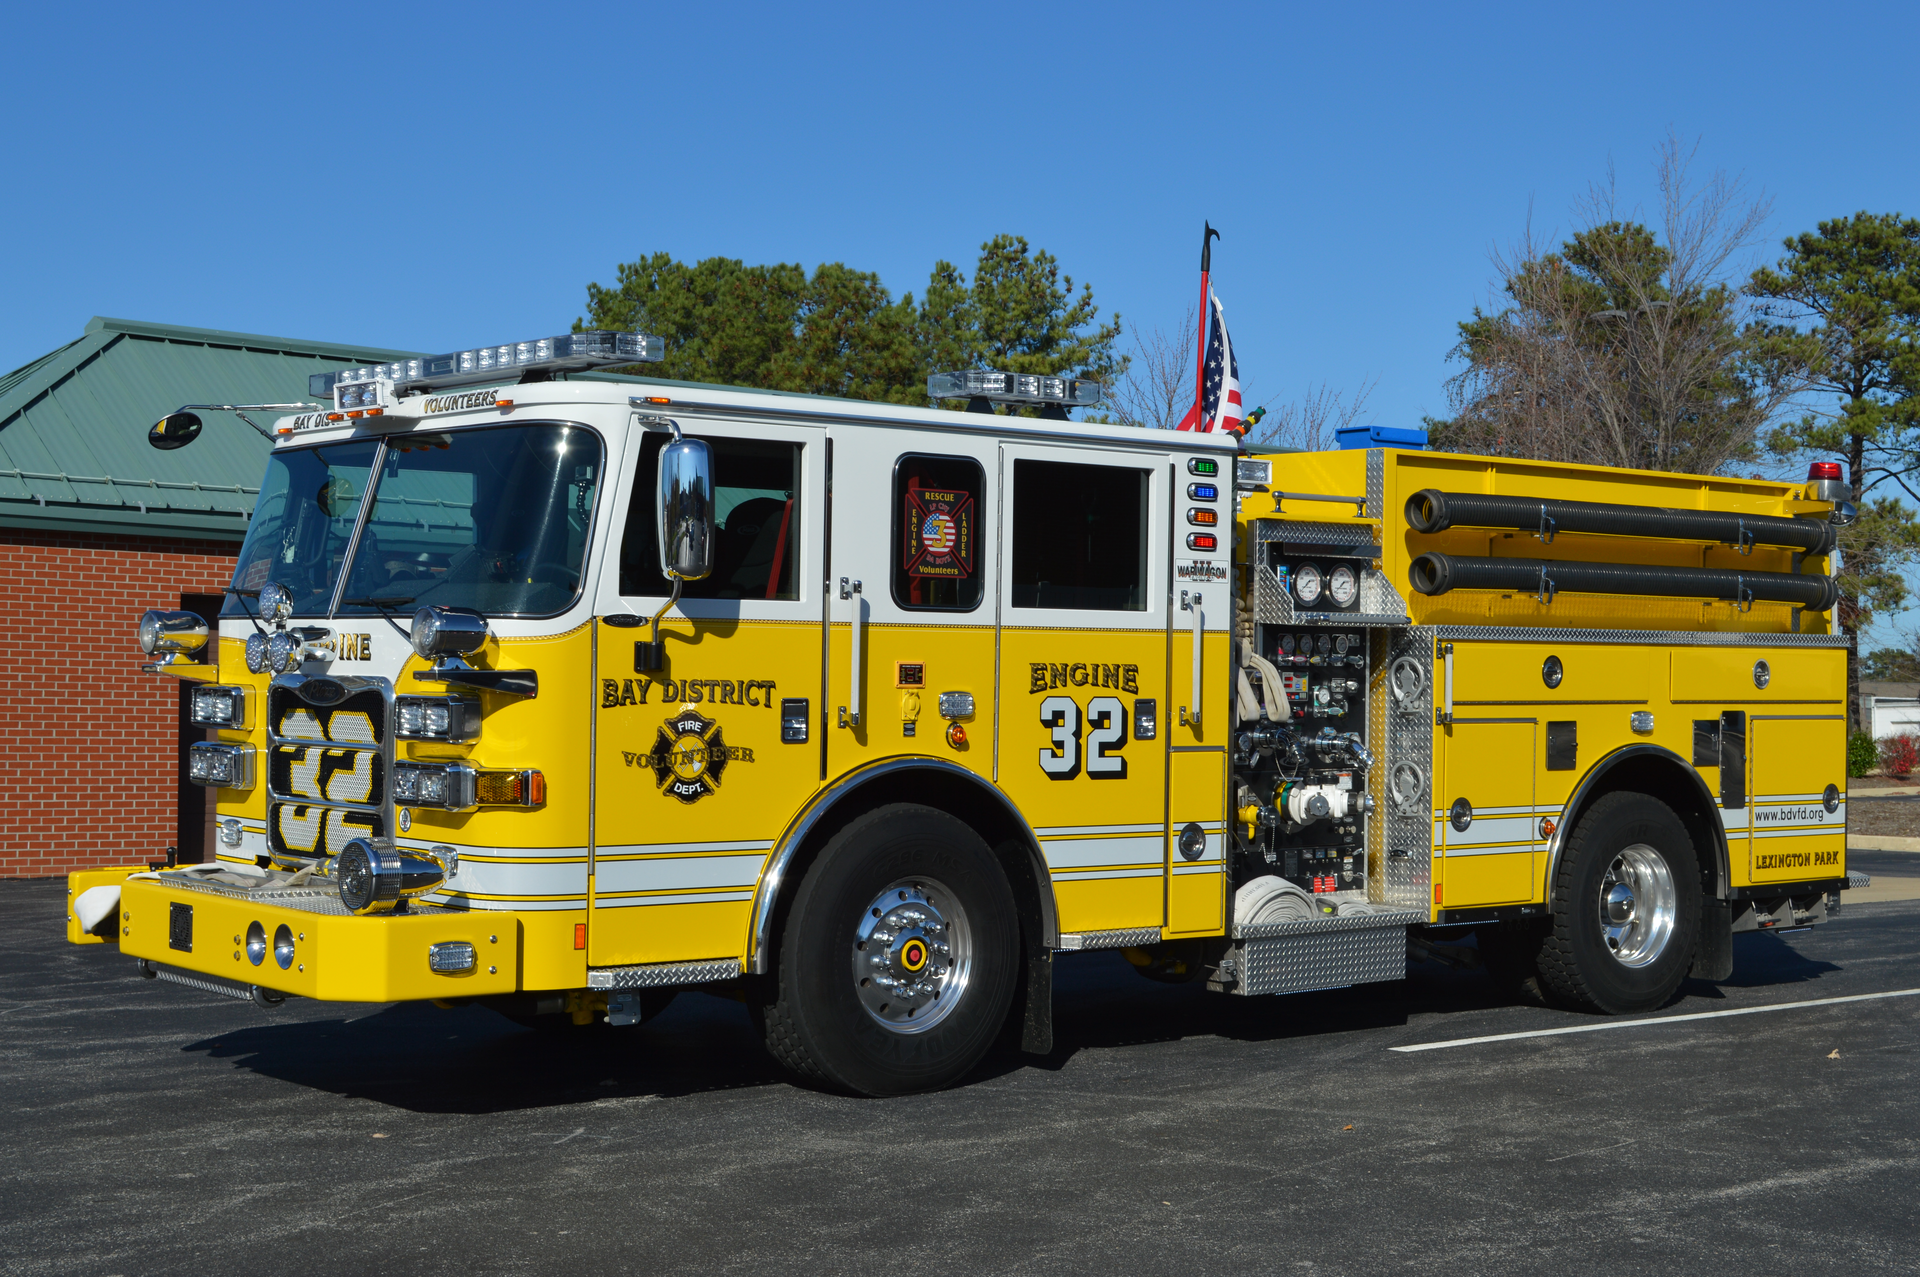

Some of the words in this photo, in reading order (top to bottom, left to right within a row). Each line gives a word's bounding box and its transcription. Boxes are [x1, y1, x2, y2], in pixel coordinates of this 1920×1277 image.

[424, 390, 499, 414] VOLUNTEERS
[293, 414, 314, 430] BAY
[925, 492, 954, 502] RESCUE
[931, 520, 947, 548] 3
[919, 565, 959, 575] Volunteers
[1177, 565, 1195, 578] WAR
[1198, 566, 1227, 579] WAGON
[339, 633, 372, 661] INE
[1028, 662, 1140, 695] ENGINE
[601, 678, 653, 708] BAY
[662, 679, 777, 708] DISTRICT
[677, 720, 703, 732] FIRE
[1038, 696, 1129, 781] 32
[621, 745, 756, 769] VOLUNTEER
[279, 708, 379, 856] 32
[673, 782, 704, 795] DEPT.
[1755, 807, 1824, 822] www.bdvfd.org
[1756, 852, 1811, 869] LEXINGTON
[1814, 851, 1840, 866] PARK
